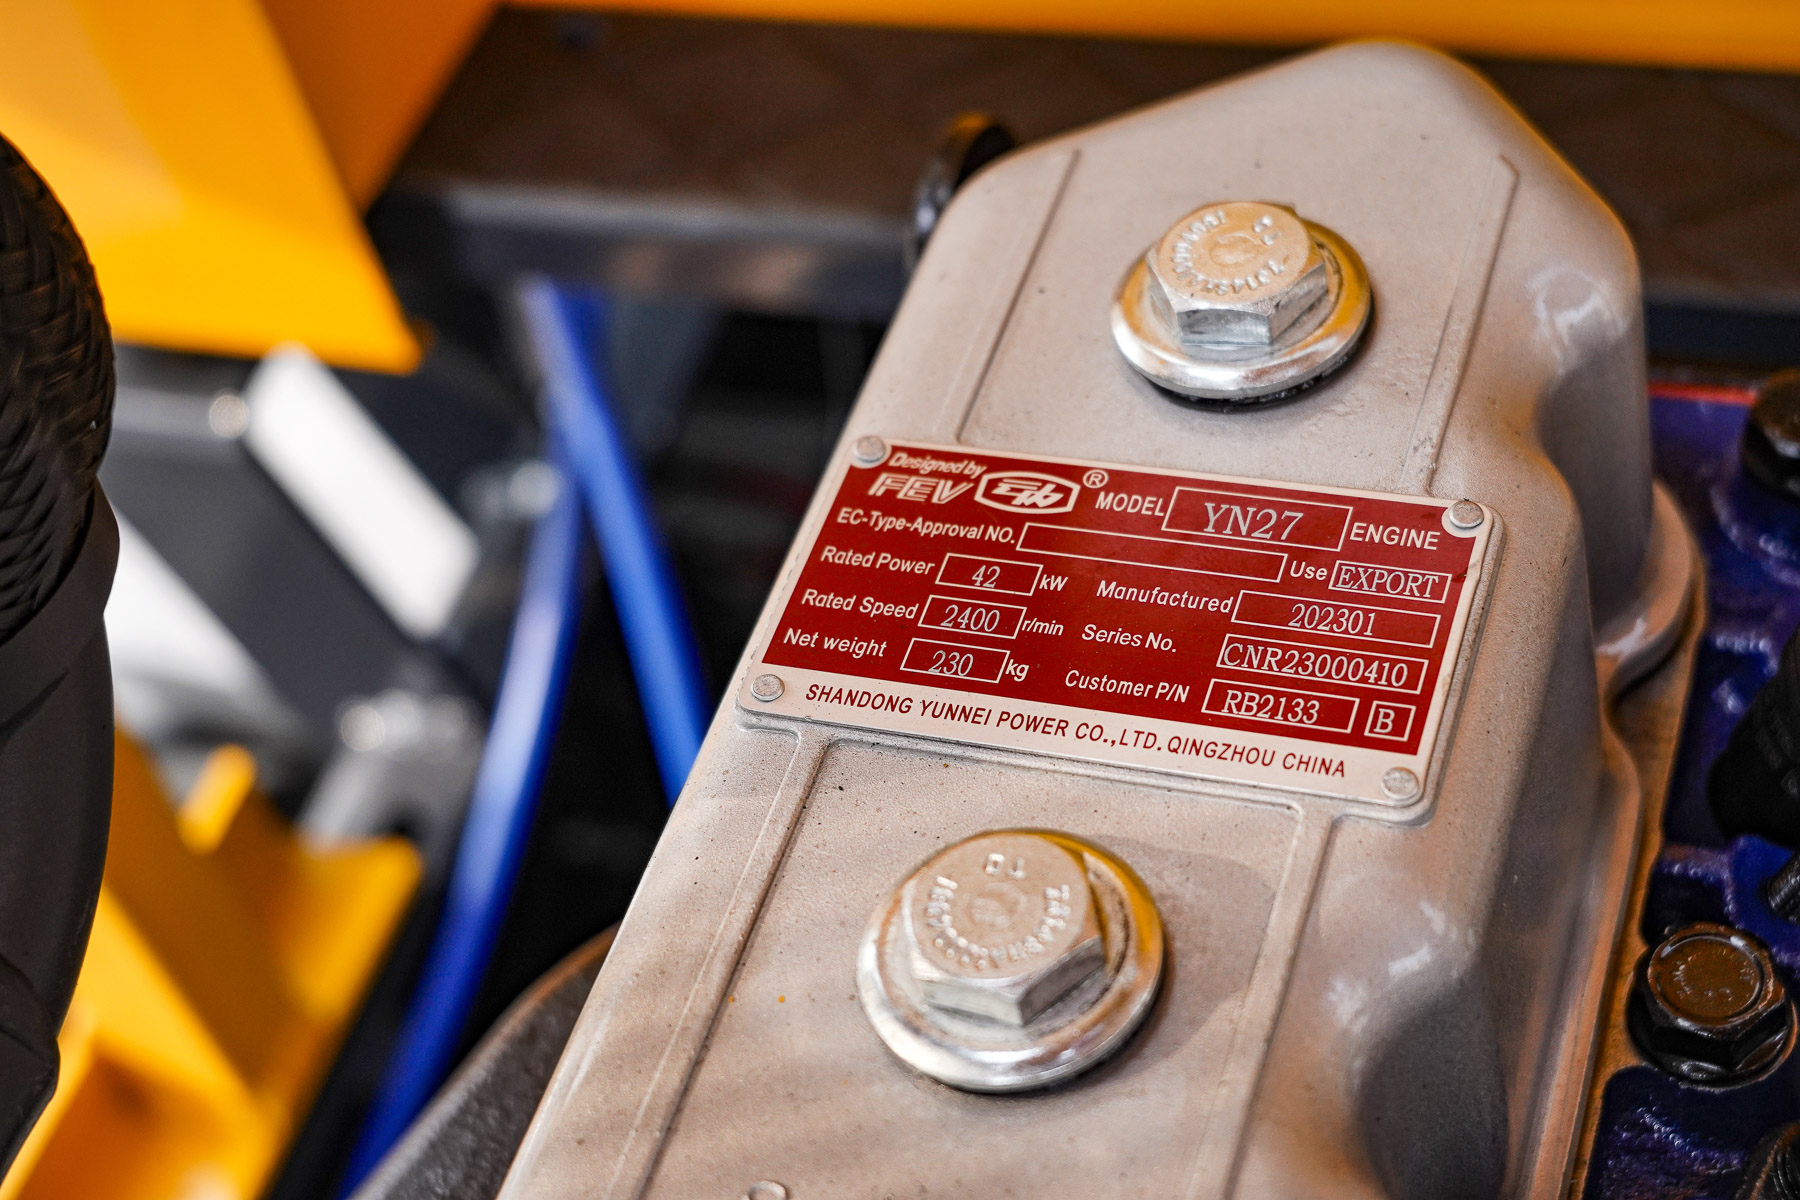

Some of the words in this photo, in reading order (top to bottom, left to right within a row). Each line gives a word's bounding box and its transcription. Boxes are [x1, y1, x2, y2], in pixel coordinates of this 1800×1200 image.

[868, 472, 975, 504] FEV
[888, 452, 962, 475] Designed
[962, 460, 987, 479] by
[836, 507, 982, 540] EC-Type-Approval
[984, 526, 1016, 544] NO.
[1095, 490, 1166, 517] MODEL
[1203, 502, 1304, 541] YN27
[1349, 522, 1441, 551] ENGINE
[820, 545, 876, 567] Rated
[876, 553, 935, 575] Power
[972, 565, 1001, 588] 42
[1039, 574, 1069, 592] kW
[1289, 560, 1328, 581] Use
[1335, 565, 1440, 598] EXPORT
[801, 589, 856, 611] Rated
[859, 597, 919, 620] Speed
[940, 604, 1000, 632] 2400
[1022, 618, 1064, 636] r/min
[1096, 580, 1234, 614] Manufactured
[1288, 603, 1376, 636] 202301
[783, 628, 819, 648] Net
[823, 637, 887, 660] weight
[928, 650, 974, 676] 230
[1005, 659, 1029, 682] kg
[1081, 624, 1142, 649] Series
[1145, 632, 1178, 653] No.
[1223, 642, 1409, 689] CNR23000410
[1065, 669, 1154, 699] Customer
[1155, 682, 1190, 703] P/N
[1221, 689, 1320, 725] RB2133
[1373, 708, 1395, 734] B
[805, 683, 914, 715] SHANDONG
[919, 699, 993, 726] YUNNEI
[996, 710, 1070, 738] POWER
[1167, 735, 1277, 768] QINGZHOU
[1282, 753, 1346, 778] CHINA
